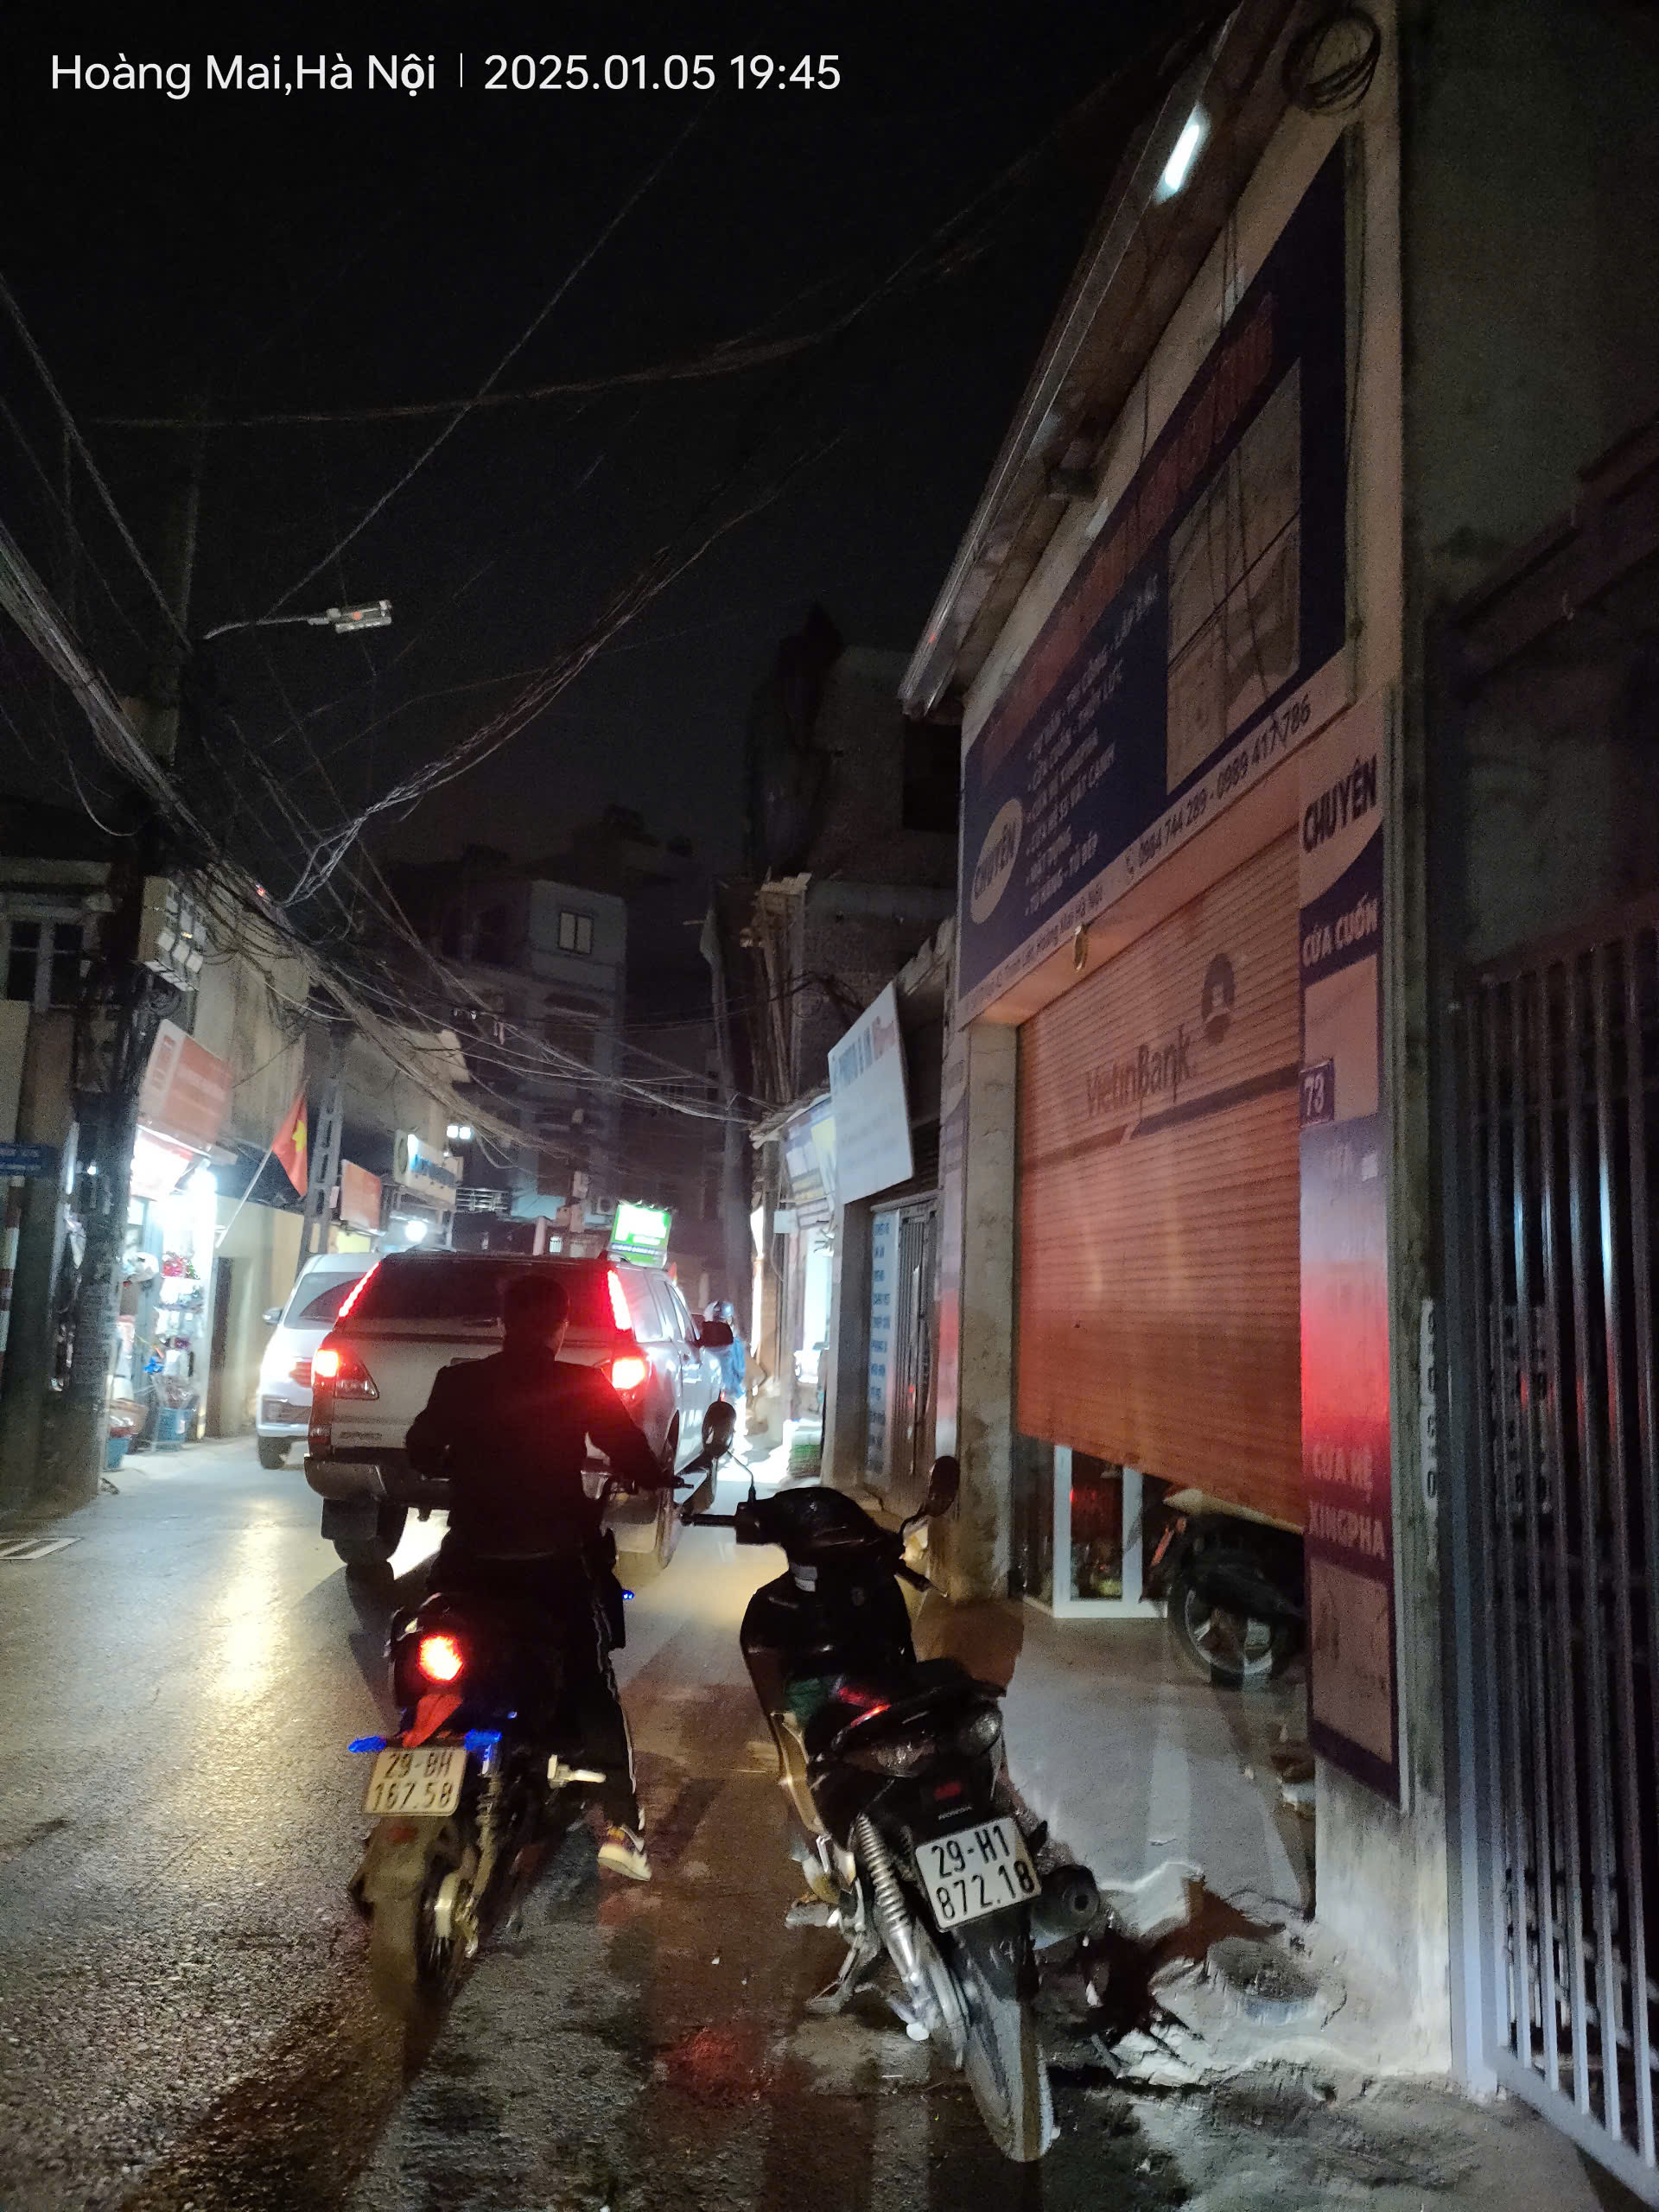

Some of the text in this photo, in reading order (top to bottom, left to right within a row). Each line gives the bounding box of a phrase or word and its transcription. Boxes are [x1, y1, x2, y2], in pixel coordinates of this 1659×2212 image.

[1303, 753, 1376, 853] CHUYÊN
[1304, 1071, 1325, 1116] 73
[931, 1825, 1010, 1878] 29-H1
[936, 1859, 1035, 1920] 872.18
